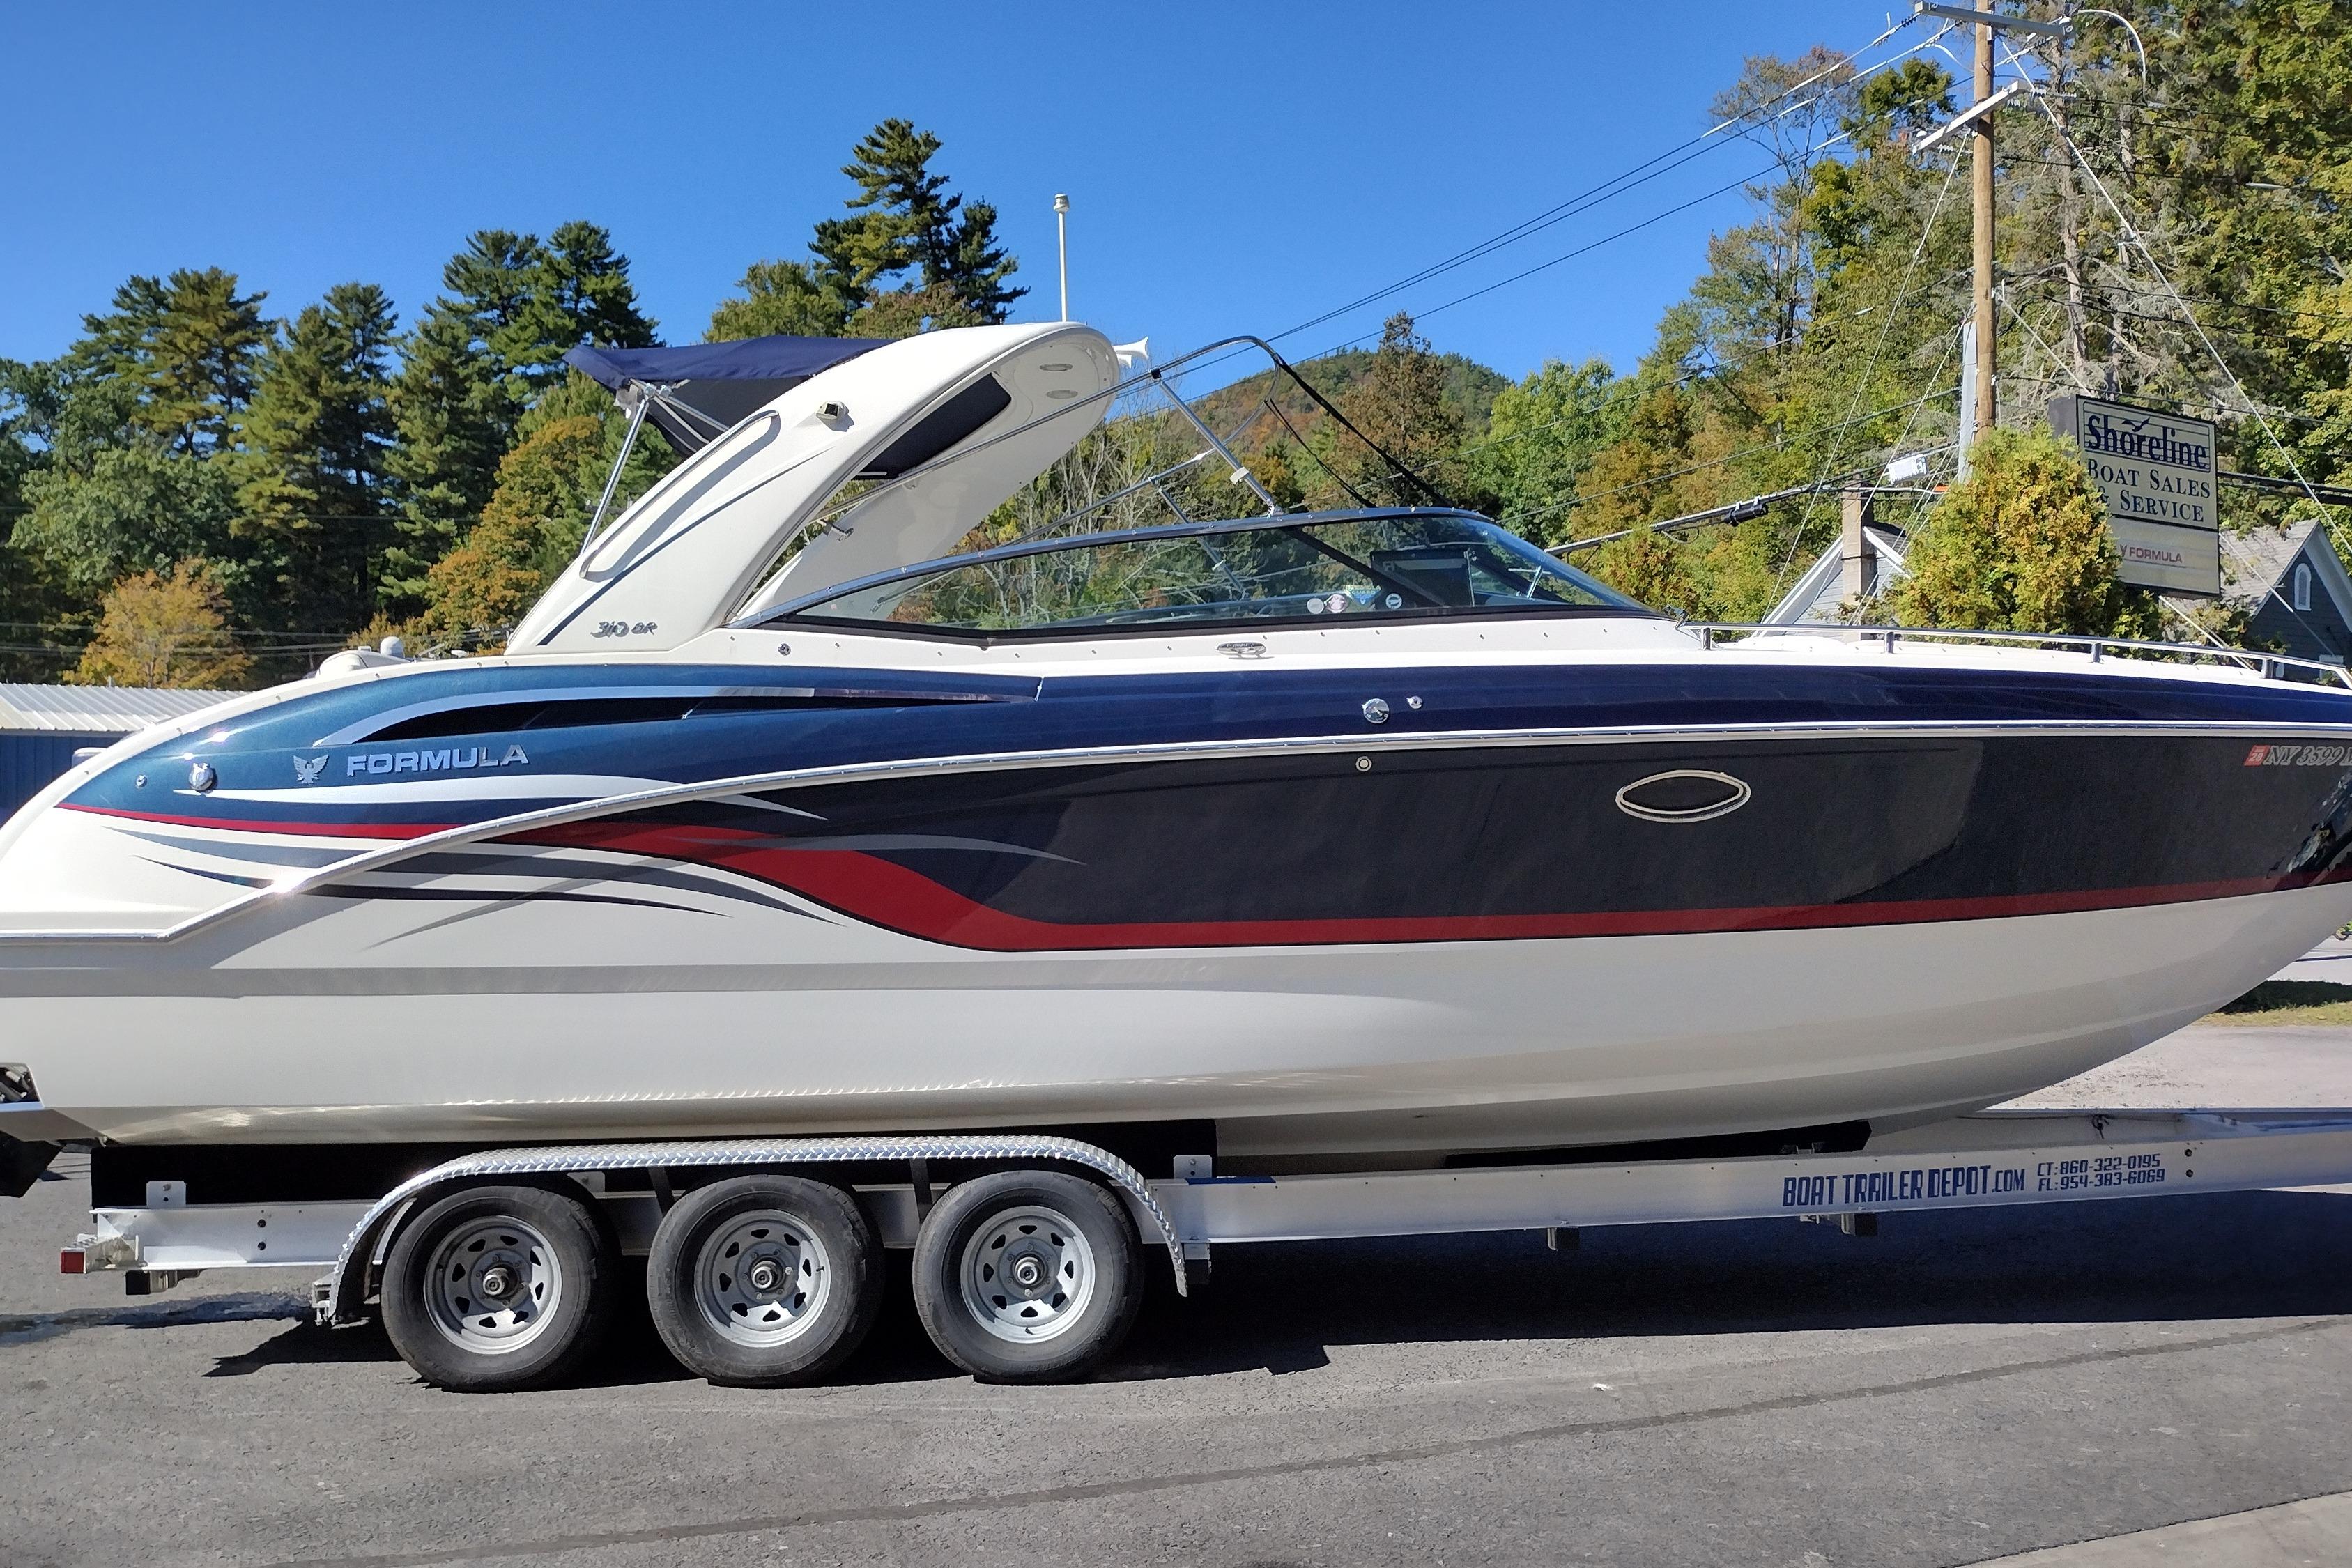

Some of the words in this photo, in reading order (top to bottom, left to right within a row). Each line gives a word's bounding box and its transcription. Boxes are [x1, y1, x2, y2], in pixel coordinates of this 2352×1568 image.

[2088, 414, 2206, 468] Shoreline
[2088, 458, 2140, 486] BOAT
[2150, 469, 2211, 499] SALES
[2120, 489, 2204, 522] SERVICE
[2129, 546, 2183, 564] FORMULA
[347, 744, 529, 776] FORMULA
[1783, 1176, 1838, 1206] BOAT
[1843, 1170, 1923, 1204] TRAILER
